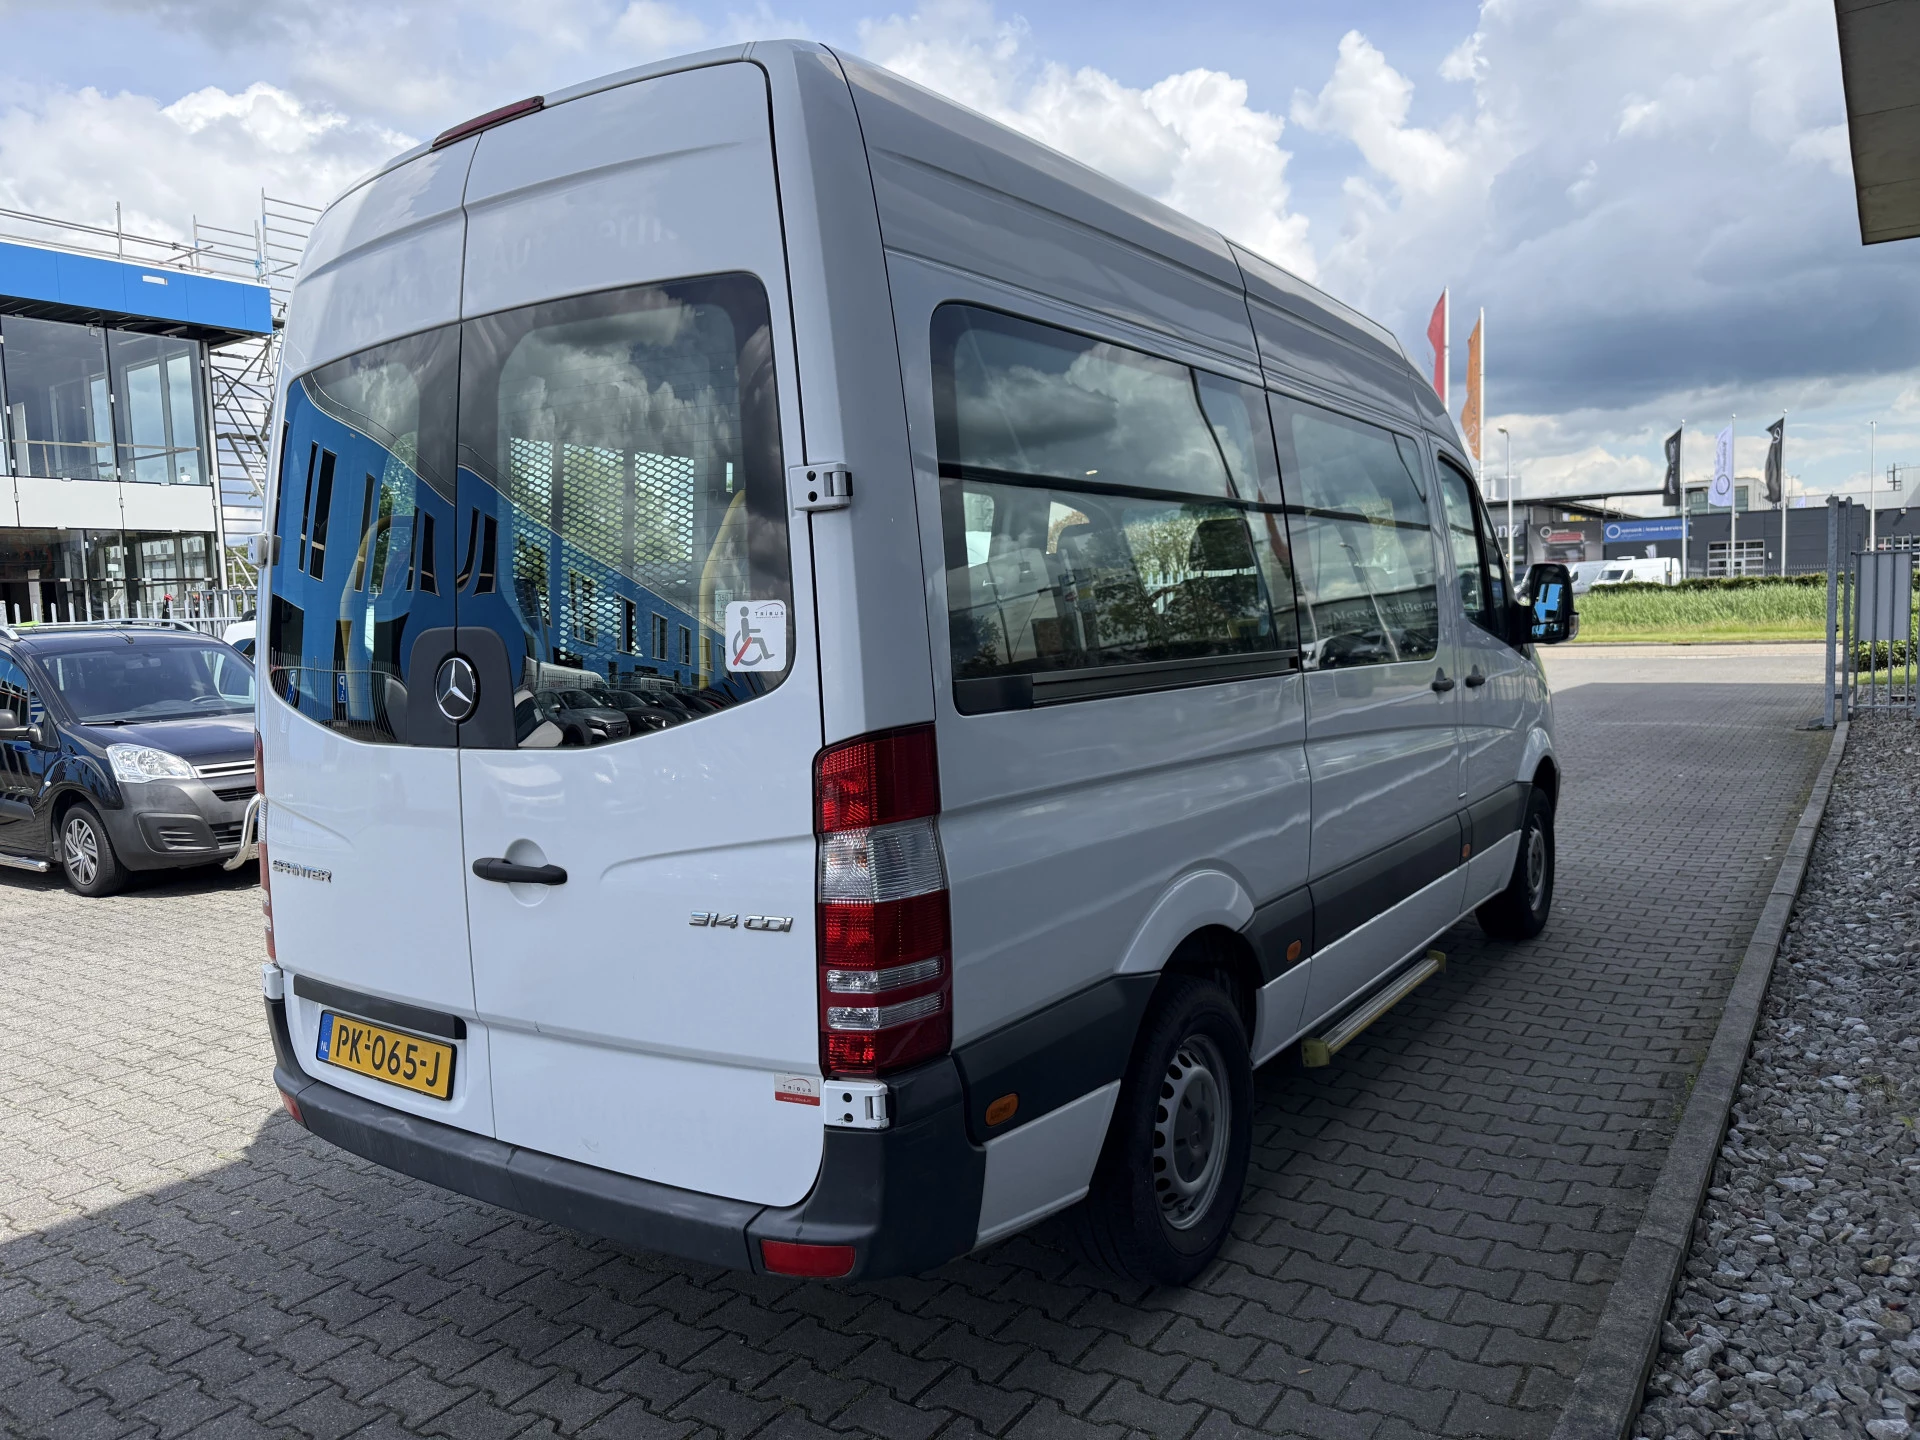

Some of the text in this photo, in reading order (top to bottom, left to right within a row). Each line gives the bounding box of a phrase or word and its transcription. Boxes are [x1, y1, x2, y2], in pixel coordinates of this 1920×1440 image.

[272, 859, 332, 883] SPRINTER
[689, 911, 793, 933] 314 CDI
[320, 1040, 329, 1053] NL
